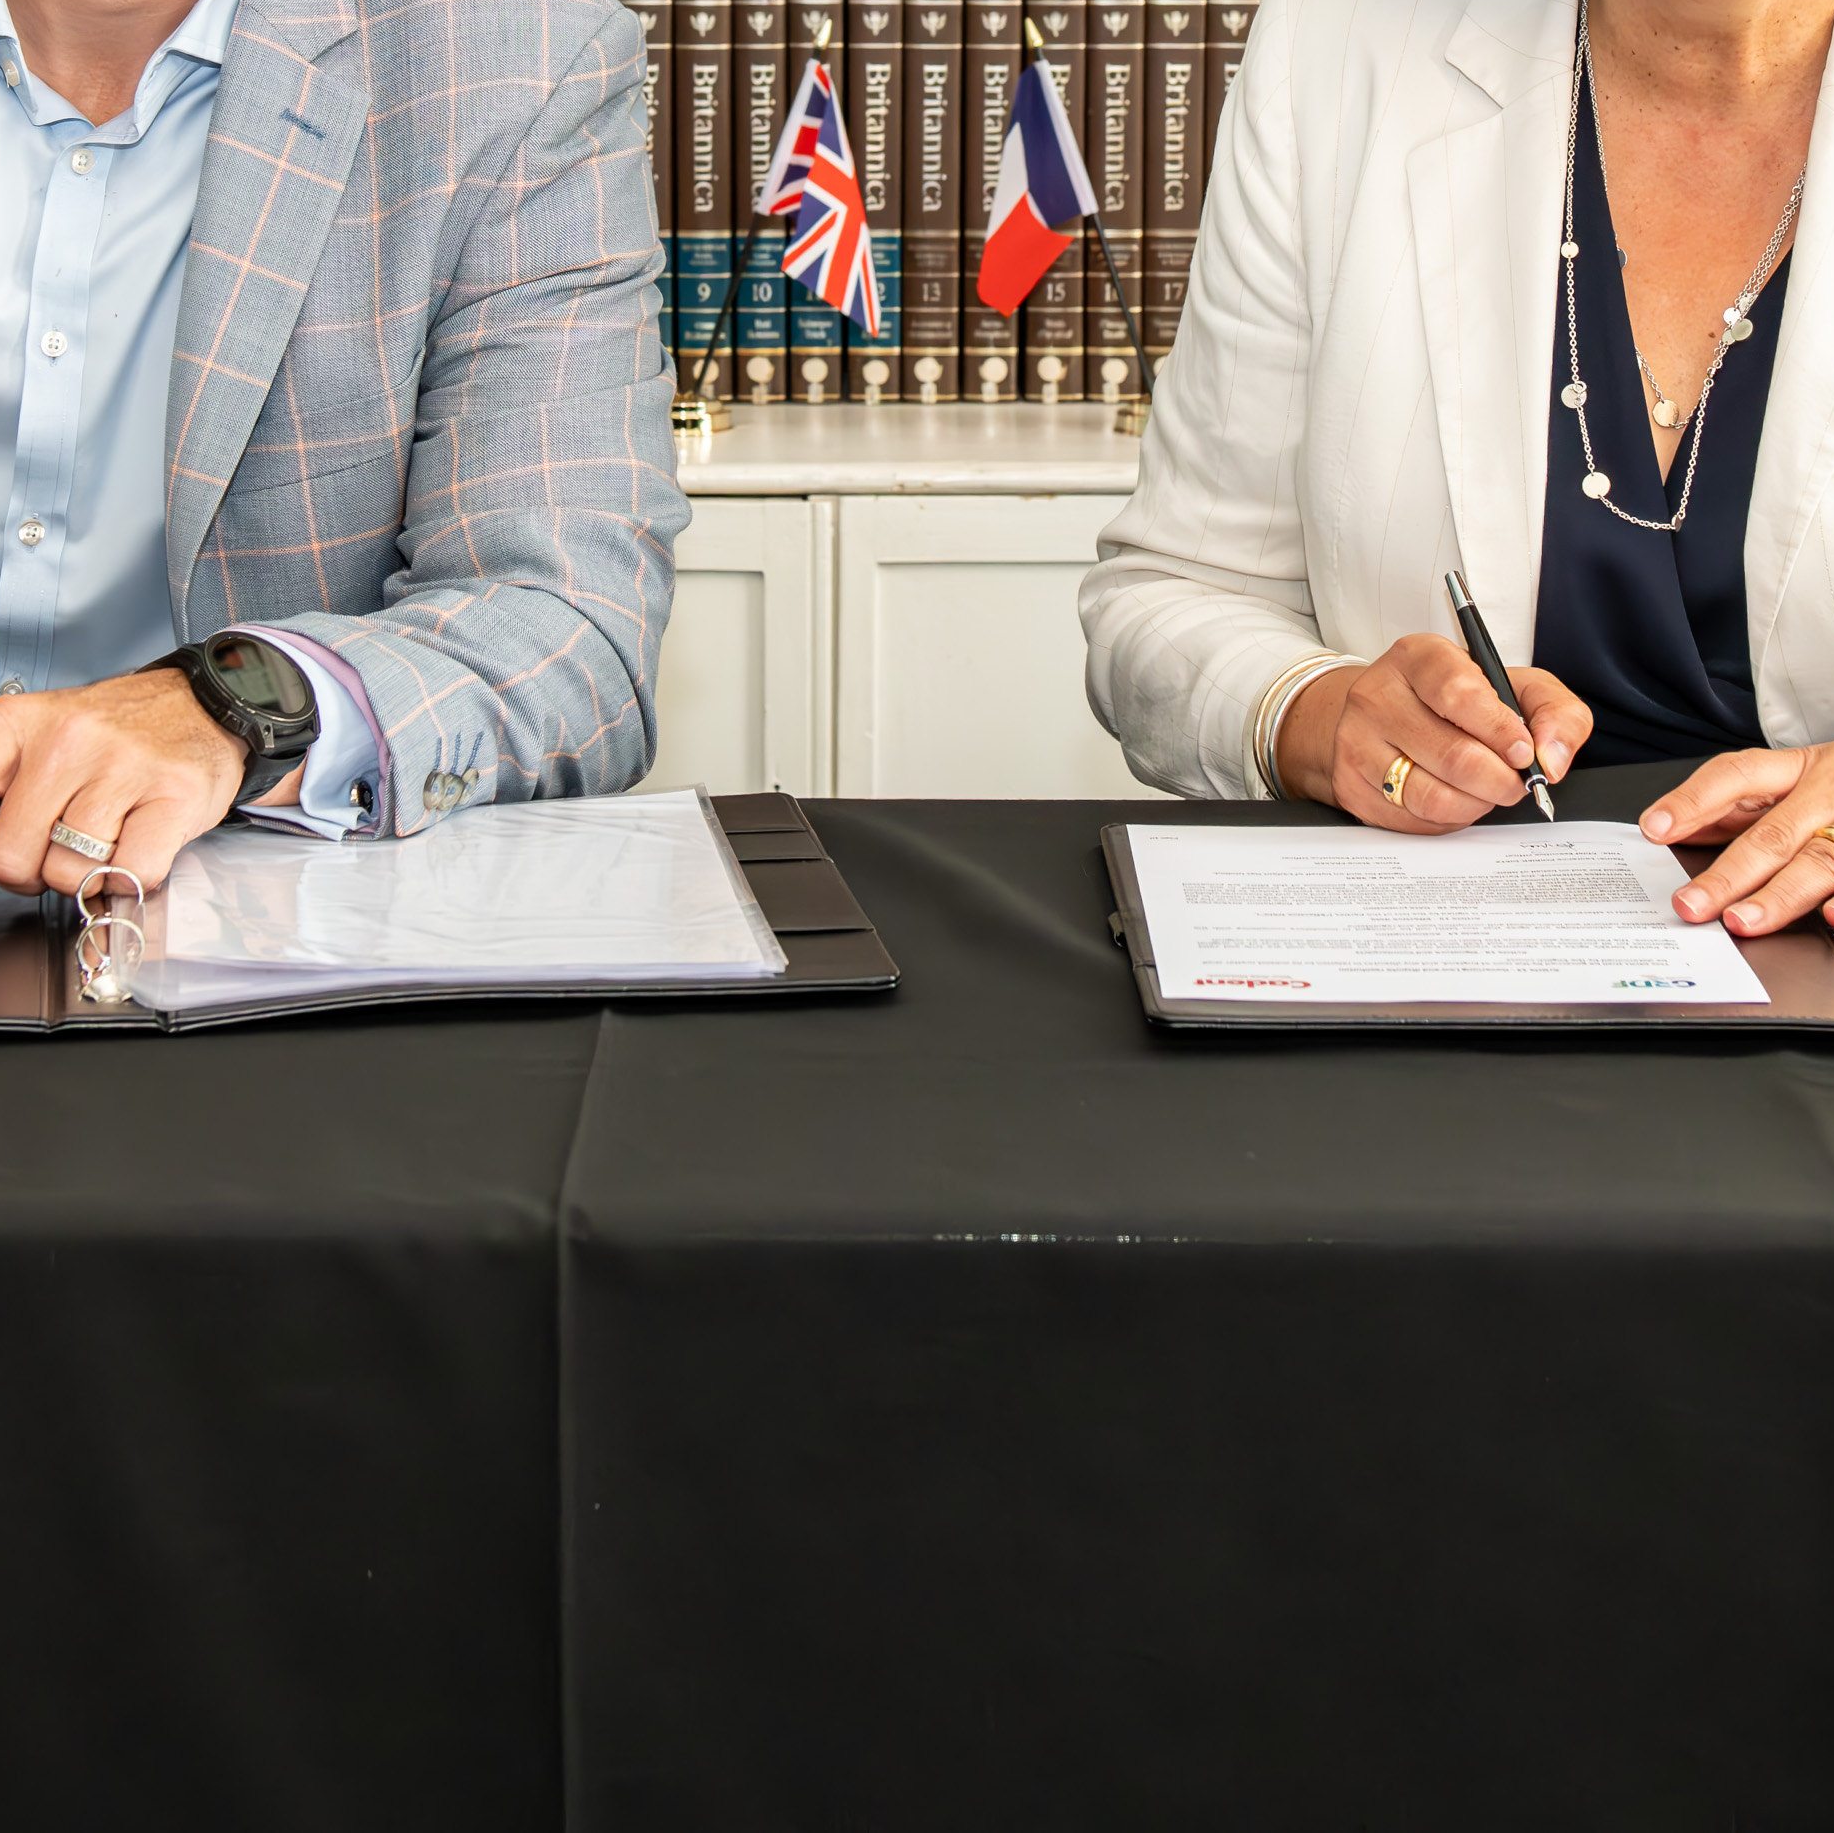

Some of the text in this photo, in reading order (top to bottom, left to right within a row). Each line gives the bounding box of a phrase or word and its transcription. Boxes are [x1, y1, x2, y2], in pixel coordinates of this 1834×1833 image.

[692, 63, 719, 214] Britannica
[749, 63, 777, 210] Britannica
[865, 63, 892, 213] Britannica
[922, 63, 949, 213] Britannica
[1104, 63, 1131, 213] Britannica
[1164, 62, 1192, 213] Britannica
[697, 283, 712, 302] 9
[751, 283, 773, 302] 10
[922, 282, 942, 302] 13
[1046, 282, 1066, 302] 15
[1163, 282, 1183, 302] 17
[1193, 977, 1313, 989] Cadent
[1611, 979, 1697, 989] GRDF
